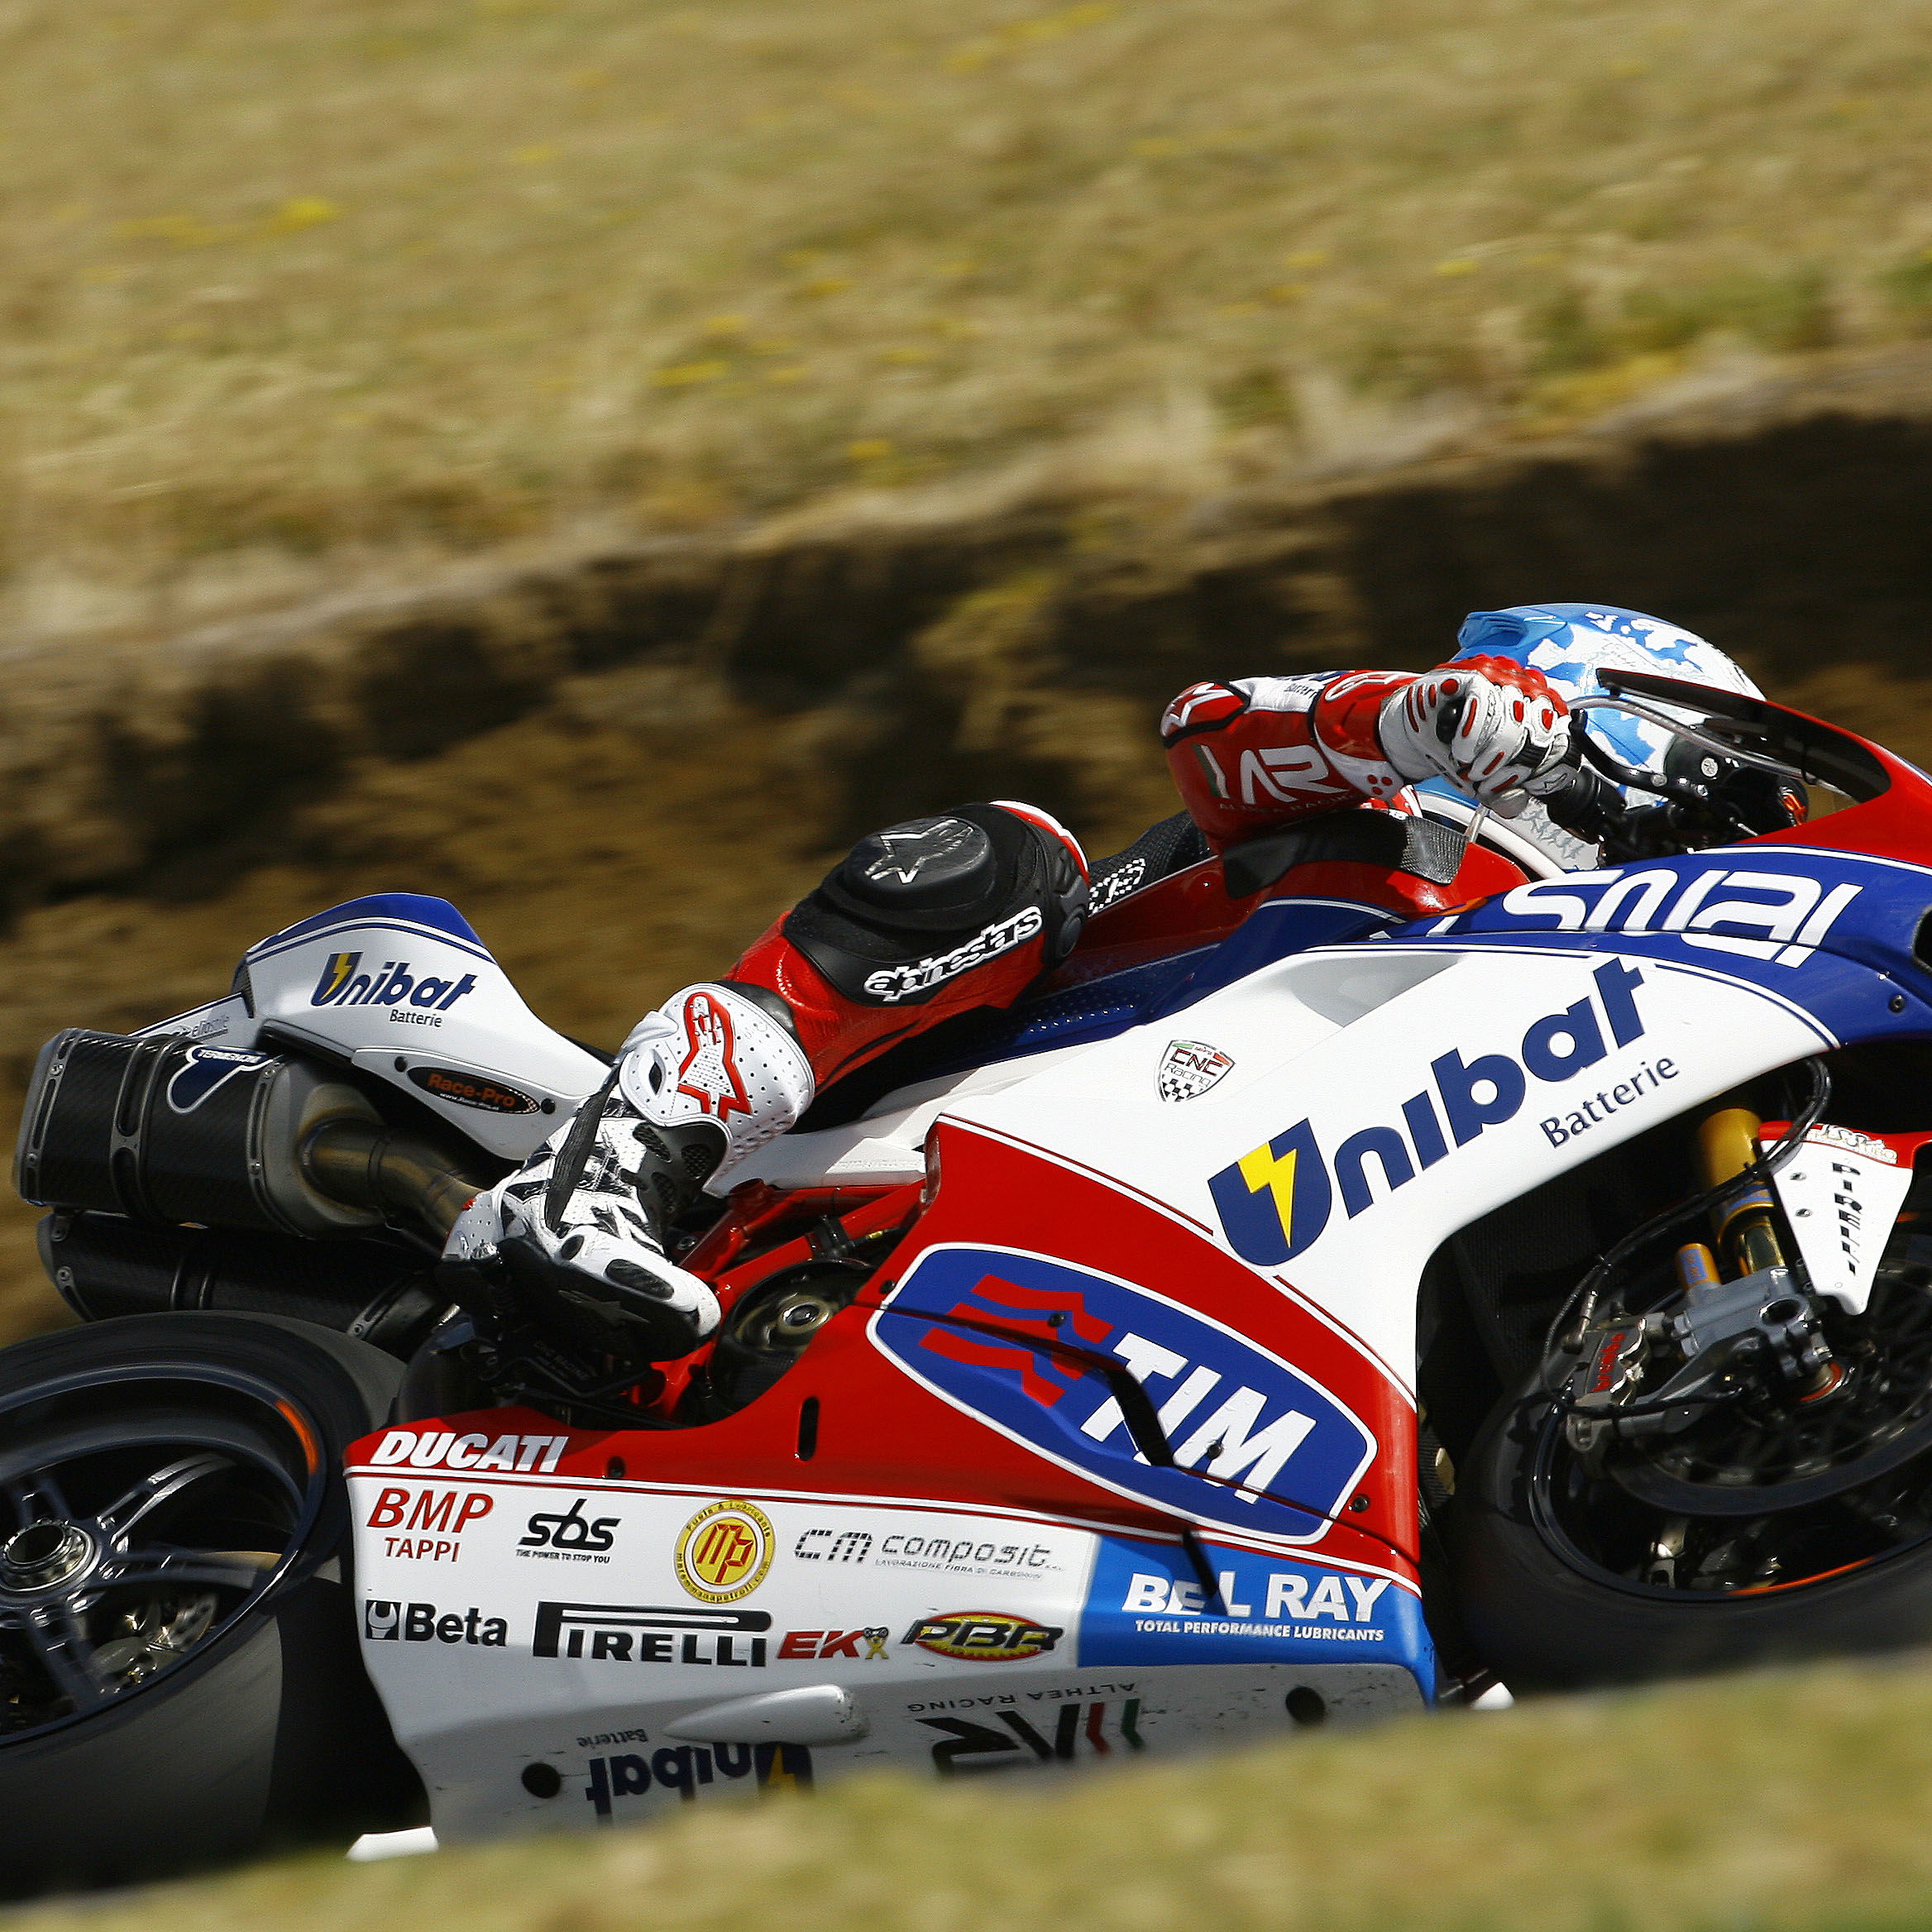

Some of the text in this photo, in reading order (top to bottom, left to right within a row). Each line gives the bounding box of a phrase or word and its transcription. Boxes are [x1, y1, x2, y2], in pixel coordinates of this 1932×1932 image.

[311, 952, 478, 1011] Unibat
[390, 1010, 443, 1028] Batterie
[1164, 1063, 1212, 1088] Racing
[1170, 1048, 1223, 1078] CNC
[427, 1074, 516, 1108] Race-Pro
[1540, 1058, 1680, 1148] Batterie
[1208, 957, 1645, 1266] Unibat
[1080, 1332, 1317, 1504] TIM
[370, 1431, 569, 1473] DUCATI
[366, 1488, 494, 1533] BMP
[385, 1537, 461, 1562] TAPPI
[516, 1549, 531, 1558] THE
[532, 1550, 560, 1561] POWER
[571, 1553, 592, 1562] STOP
[593, 1555, 610, 1564] YOU
[1265, 1573, 1393, 1624] RAY
[405, 1603, 507, 1647] Beta
[533, 1600, 772, 1667] PIRELLI
[901, 1619, 1064, 1651] PBR
[1136, 1619, 1384, 1642] TOTAL PERFORMANCE LUBRICANTS
[777, 1629, 865, 1659] EK
[907, 1682, 1136, 1712] ALTHEA RACING
[576, 1729, 649, 1748] Batterie
